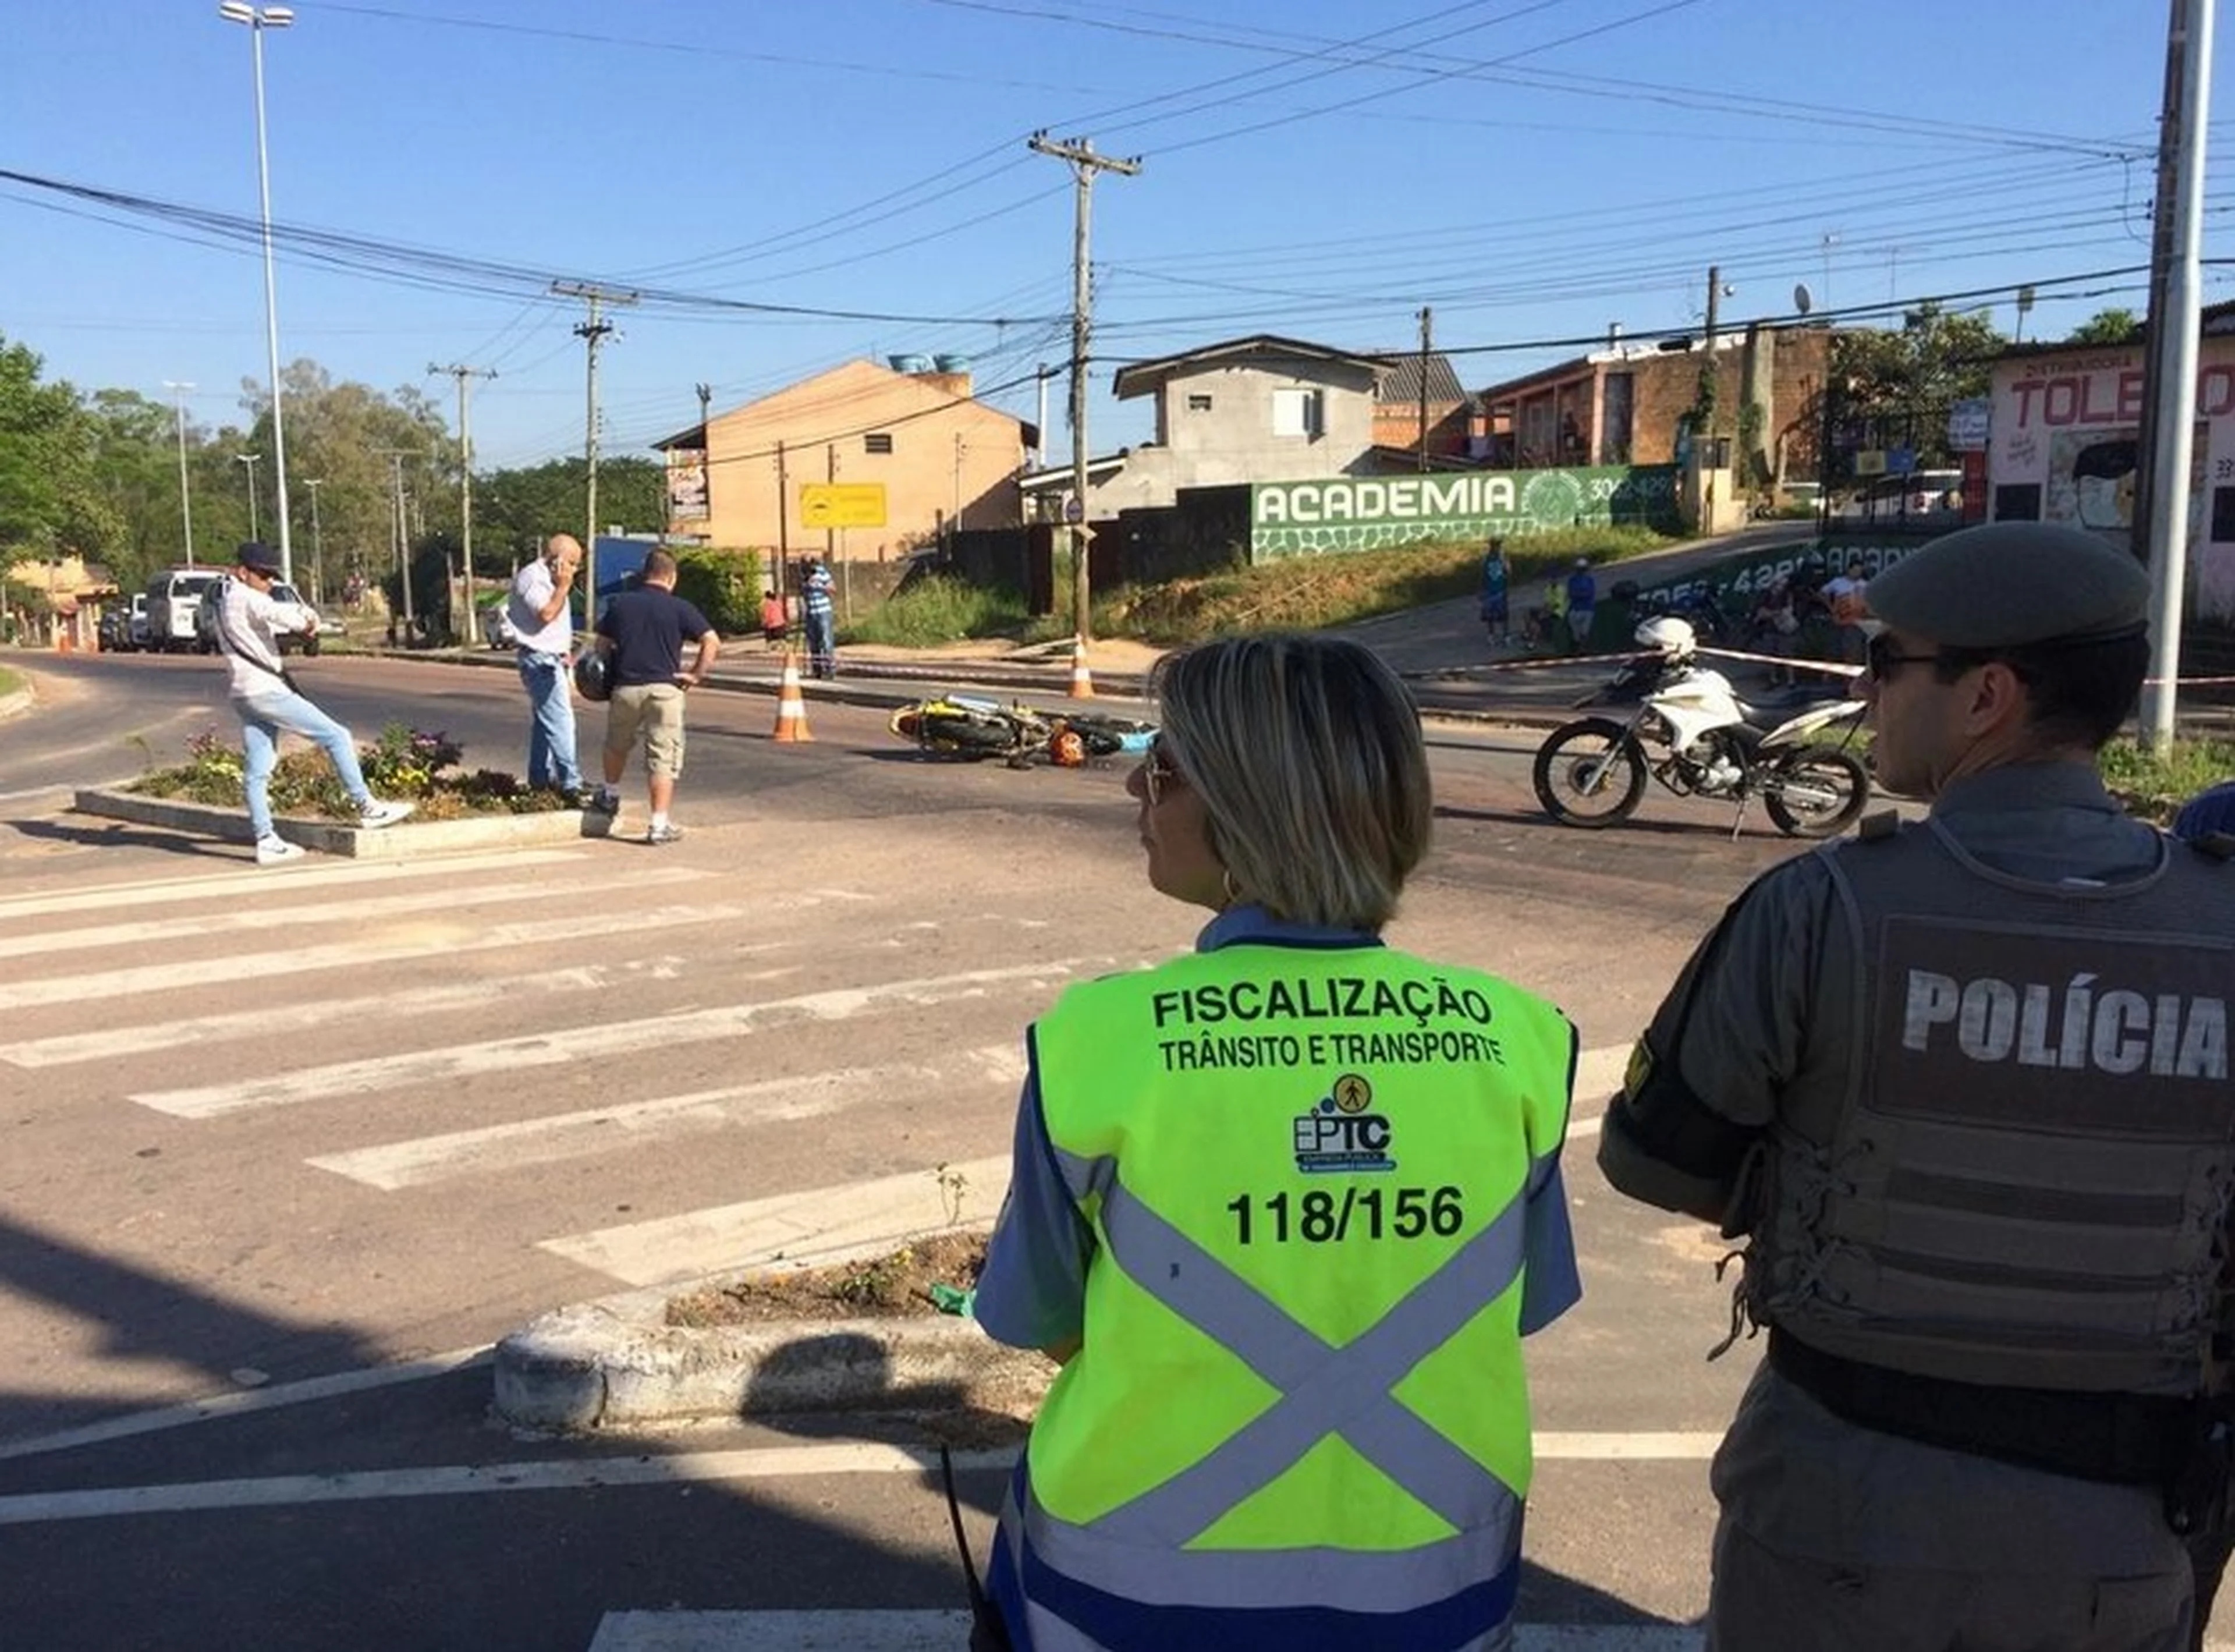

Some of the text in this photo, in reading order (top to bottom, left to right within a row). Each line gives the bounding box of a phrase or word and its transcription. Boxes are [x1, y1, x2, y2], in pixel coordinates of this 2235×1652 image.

[2012, 364, 2235, 428] TOLEO
[1257, 476, 1514, 523] ACADEMIA
[1152, 976, 1491, 1027] FISCALIZAÇÃO
[1901, 968, 2229, 1080] POLÍCIA
[1159, 1030, 1507, 1071] TRÂNSITO E TRANSPORTE
[1294, 1114, 1391, 1152] EPTC
[1227, 1186, 1463, 1245] 118/156
